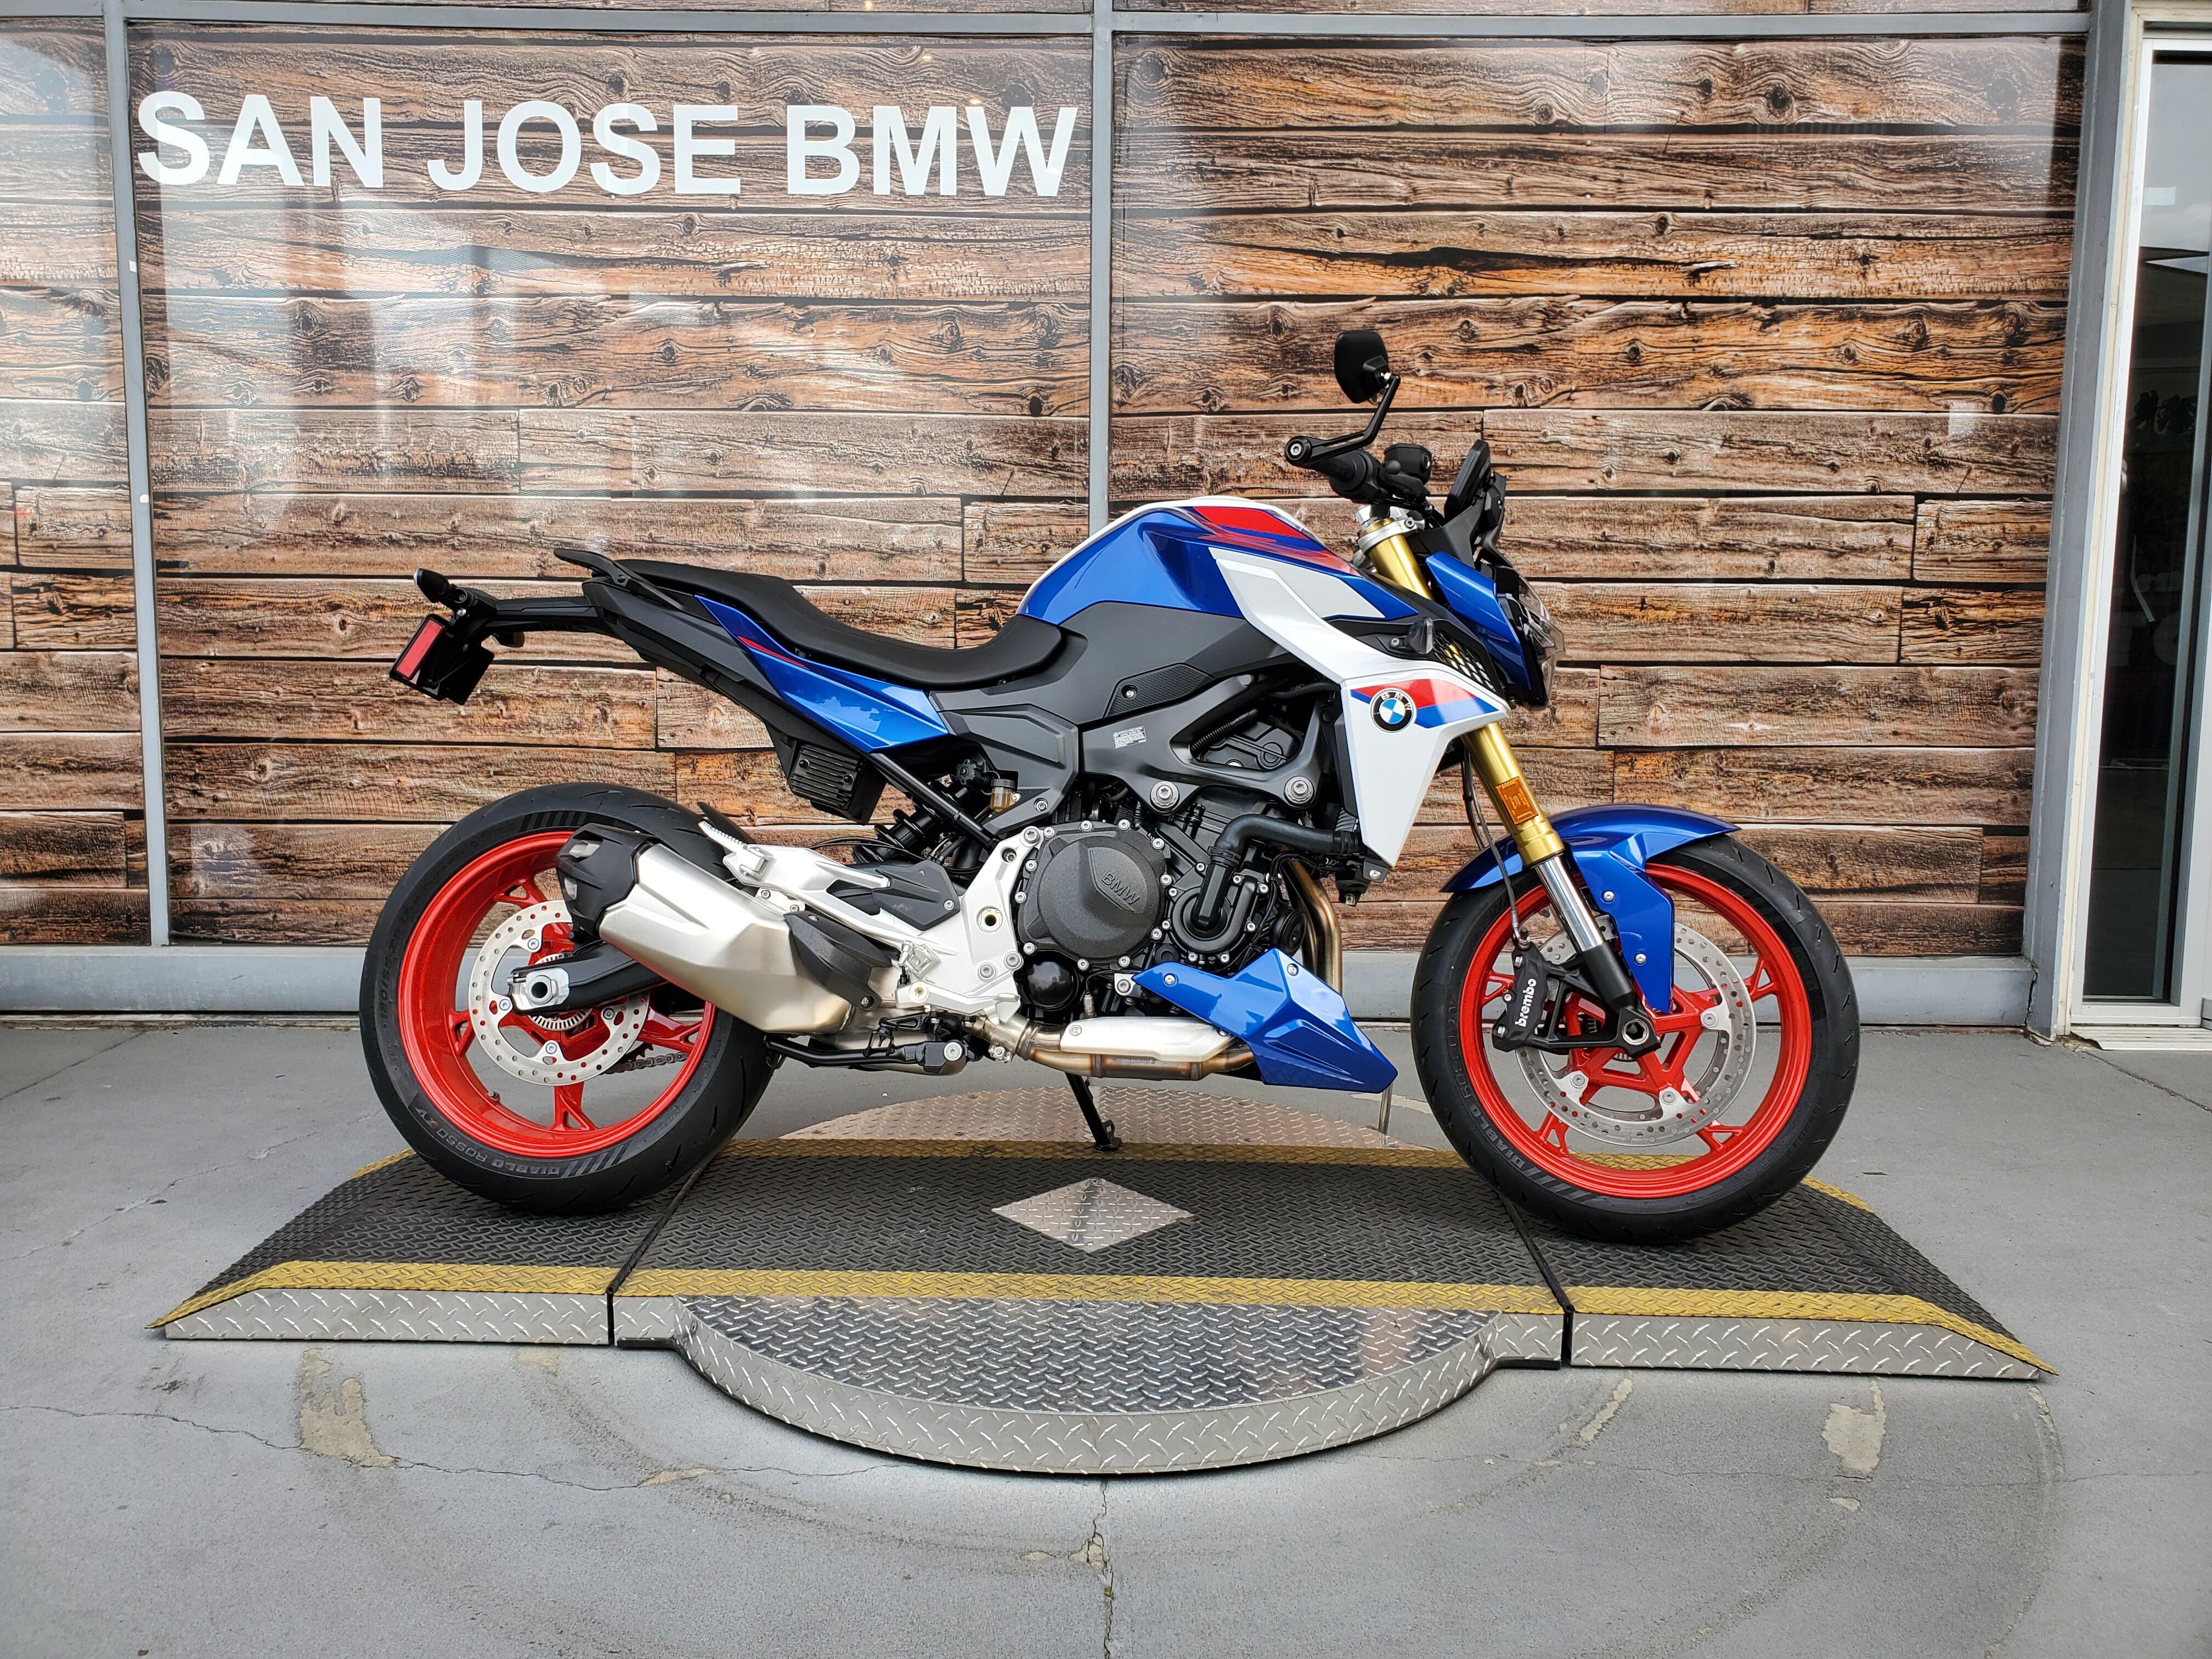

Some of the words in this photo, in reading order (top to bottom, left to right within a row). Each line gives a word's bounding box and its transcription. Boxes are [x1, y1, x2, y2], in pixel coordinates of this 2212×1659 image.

[138, 90, 384, 188] SAN
[426, 99, 741, 196] JOSE
[786, 104, 1079, 197] BMW
[1380, 691, 1412, 711] BMW
[1100, 870, 1142, 906] BMW
[1514, 978, 1537, 1028] brembo
[436, 1128, 488, 1163] ROSSO
[1470, 1103, 1526, 1169] DIABLO
[492, 1158, 560, 1175] DIABLO
